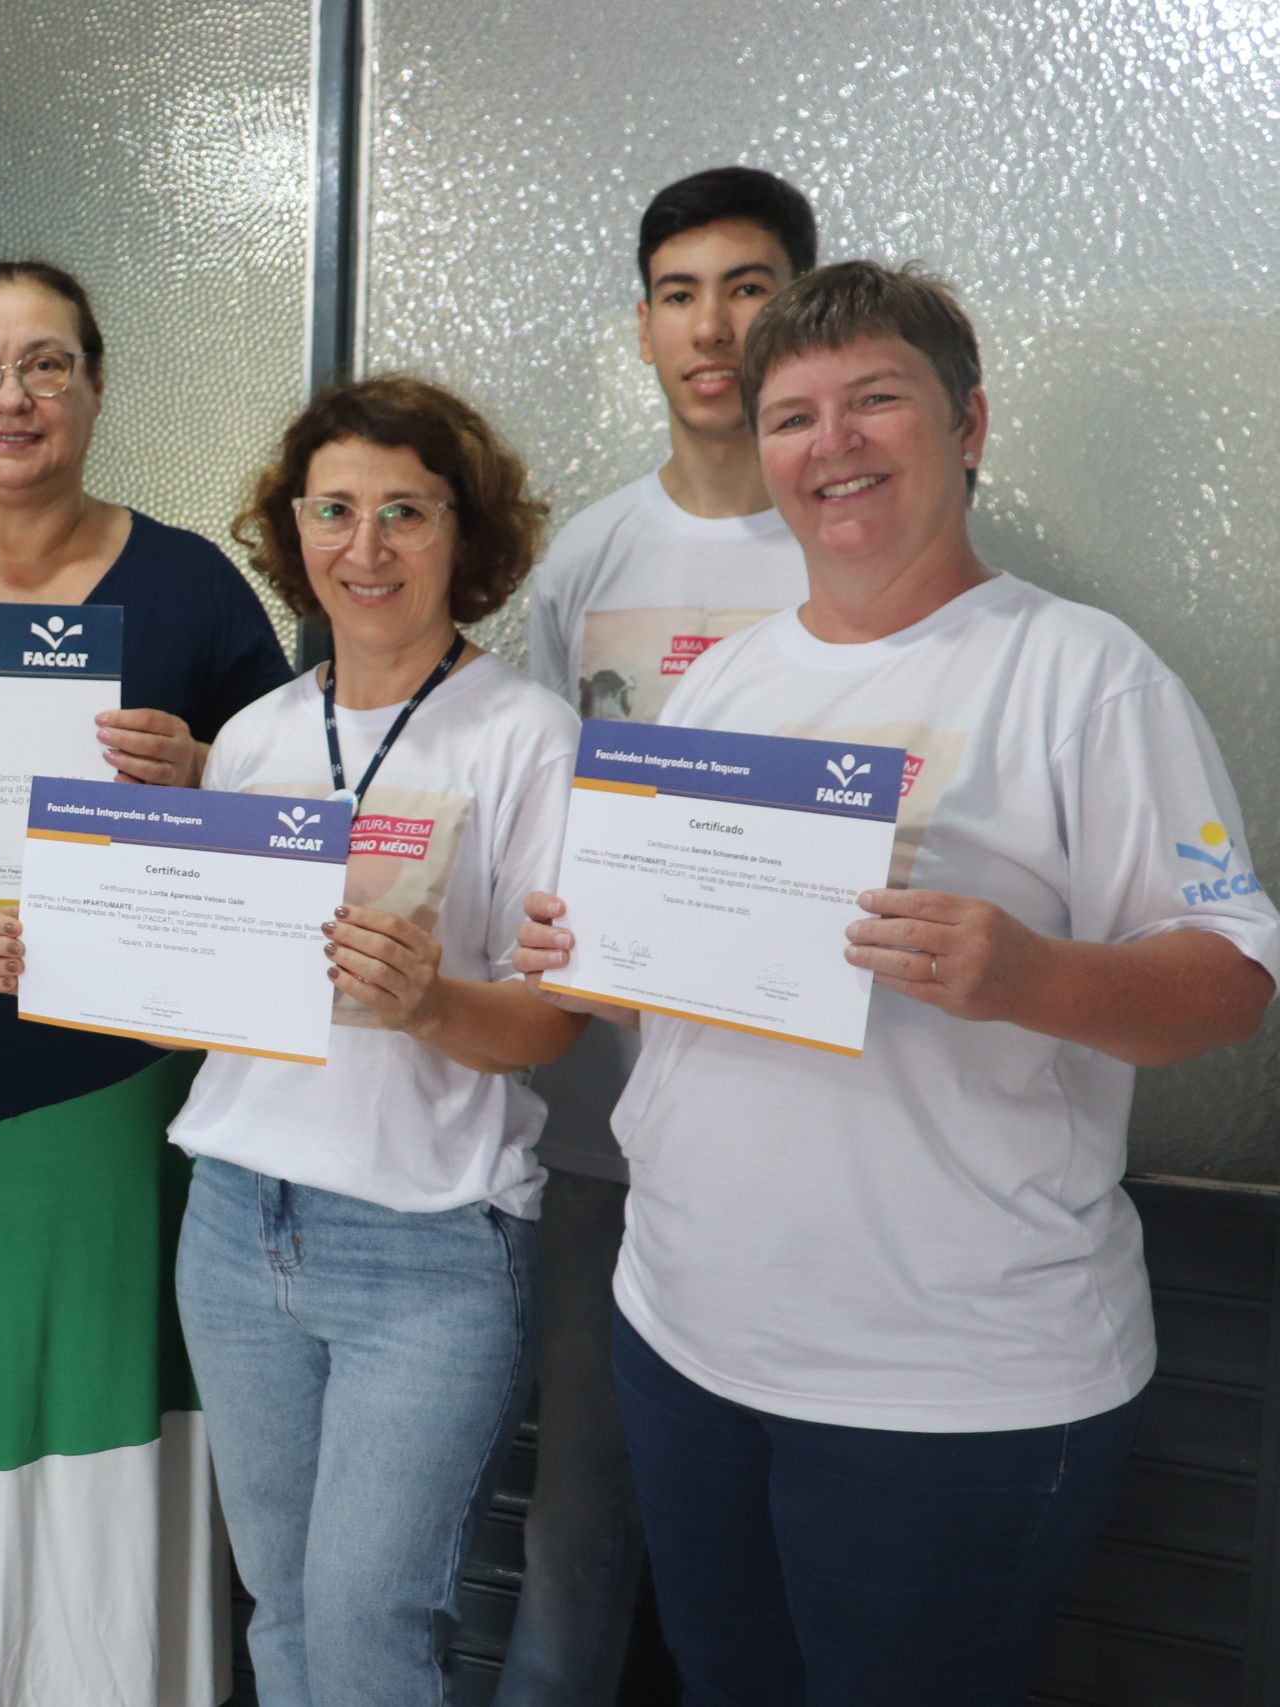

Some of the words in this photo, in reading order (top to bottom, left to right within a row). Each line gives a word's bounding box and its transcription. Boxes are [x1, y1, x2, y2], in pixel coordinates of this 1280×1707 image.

[674, 640, 704, 651] UMA
[23, 651, 88, 667] FACCAT
[595, 748, 642, 763] Faculdades
[644, 754, 693, 769] Integradas
[694, 759, 708, 770] de
[710, 761, 750, 775] Taquara
[11, 796, 24, 805] 40
[816, 787, 872, 807] FACCAT
[46, 802, 94, 815] Faculdades
[96, 806, 145, 820] Integradas
[147, 811, 160, 821] de
[162, 812, 202, 825] Taquara
[394, 822, 431, 834] STEM
[689, 819, 744, 836] Certificado
[269, 834, 324, 851] FACCAT
[379, 839, 424, 856] MÉDIO
[145, 864, 200, 878] Certificado
